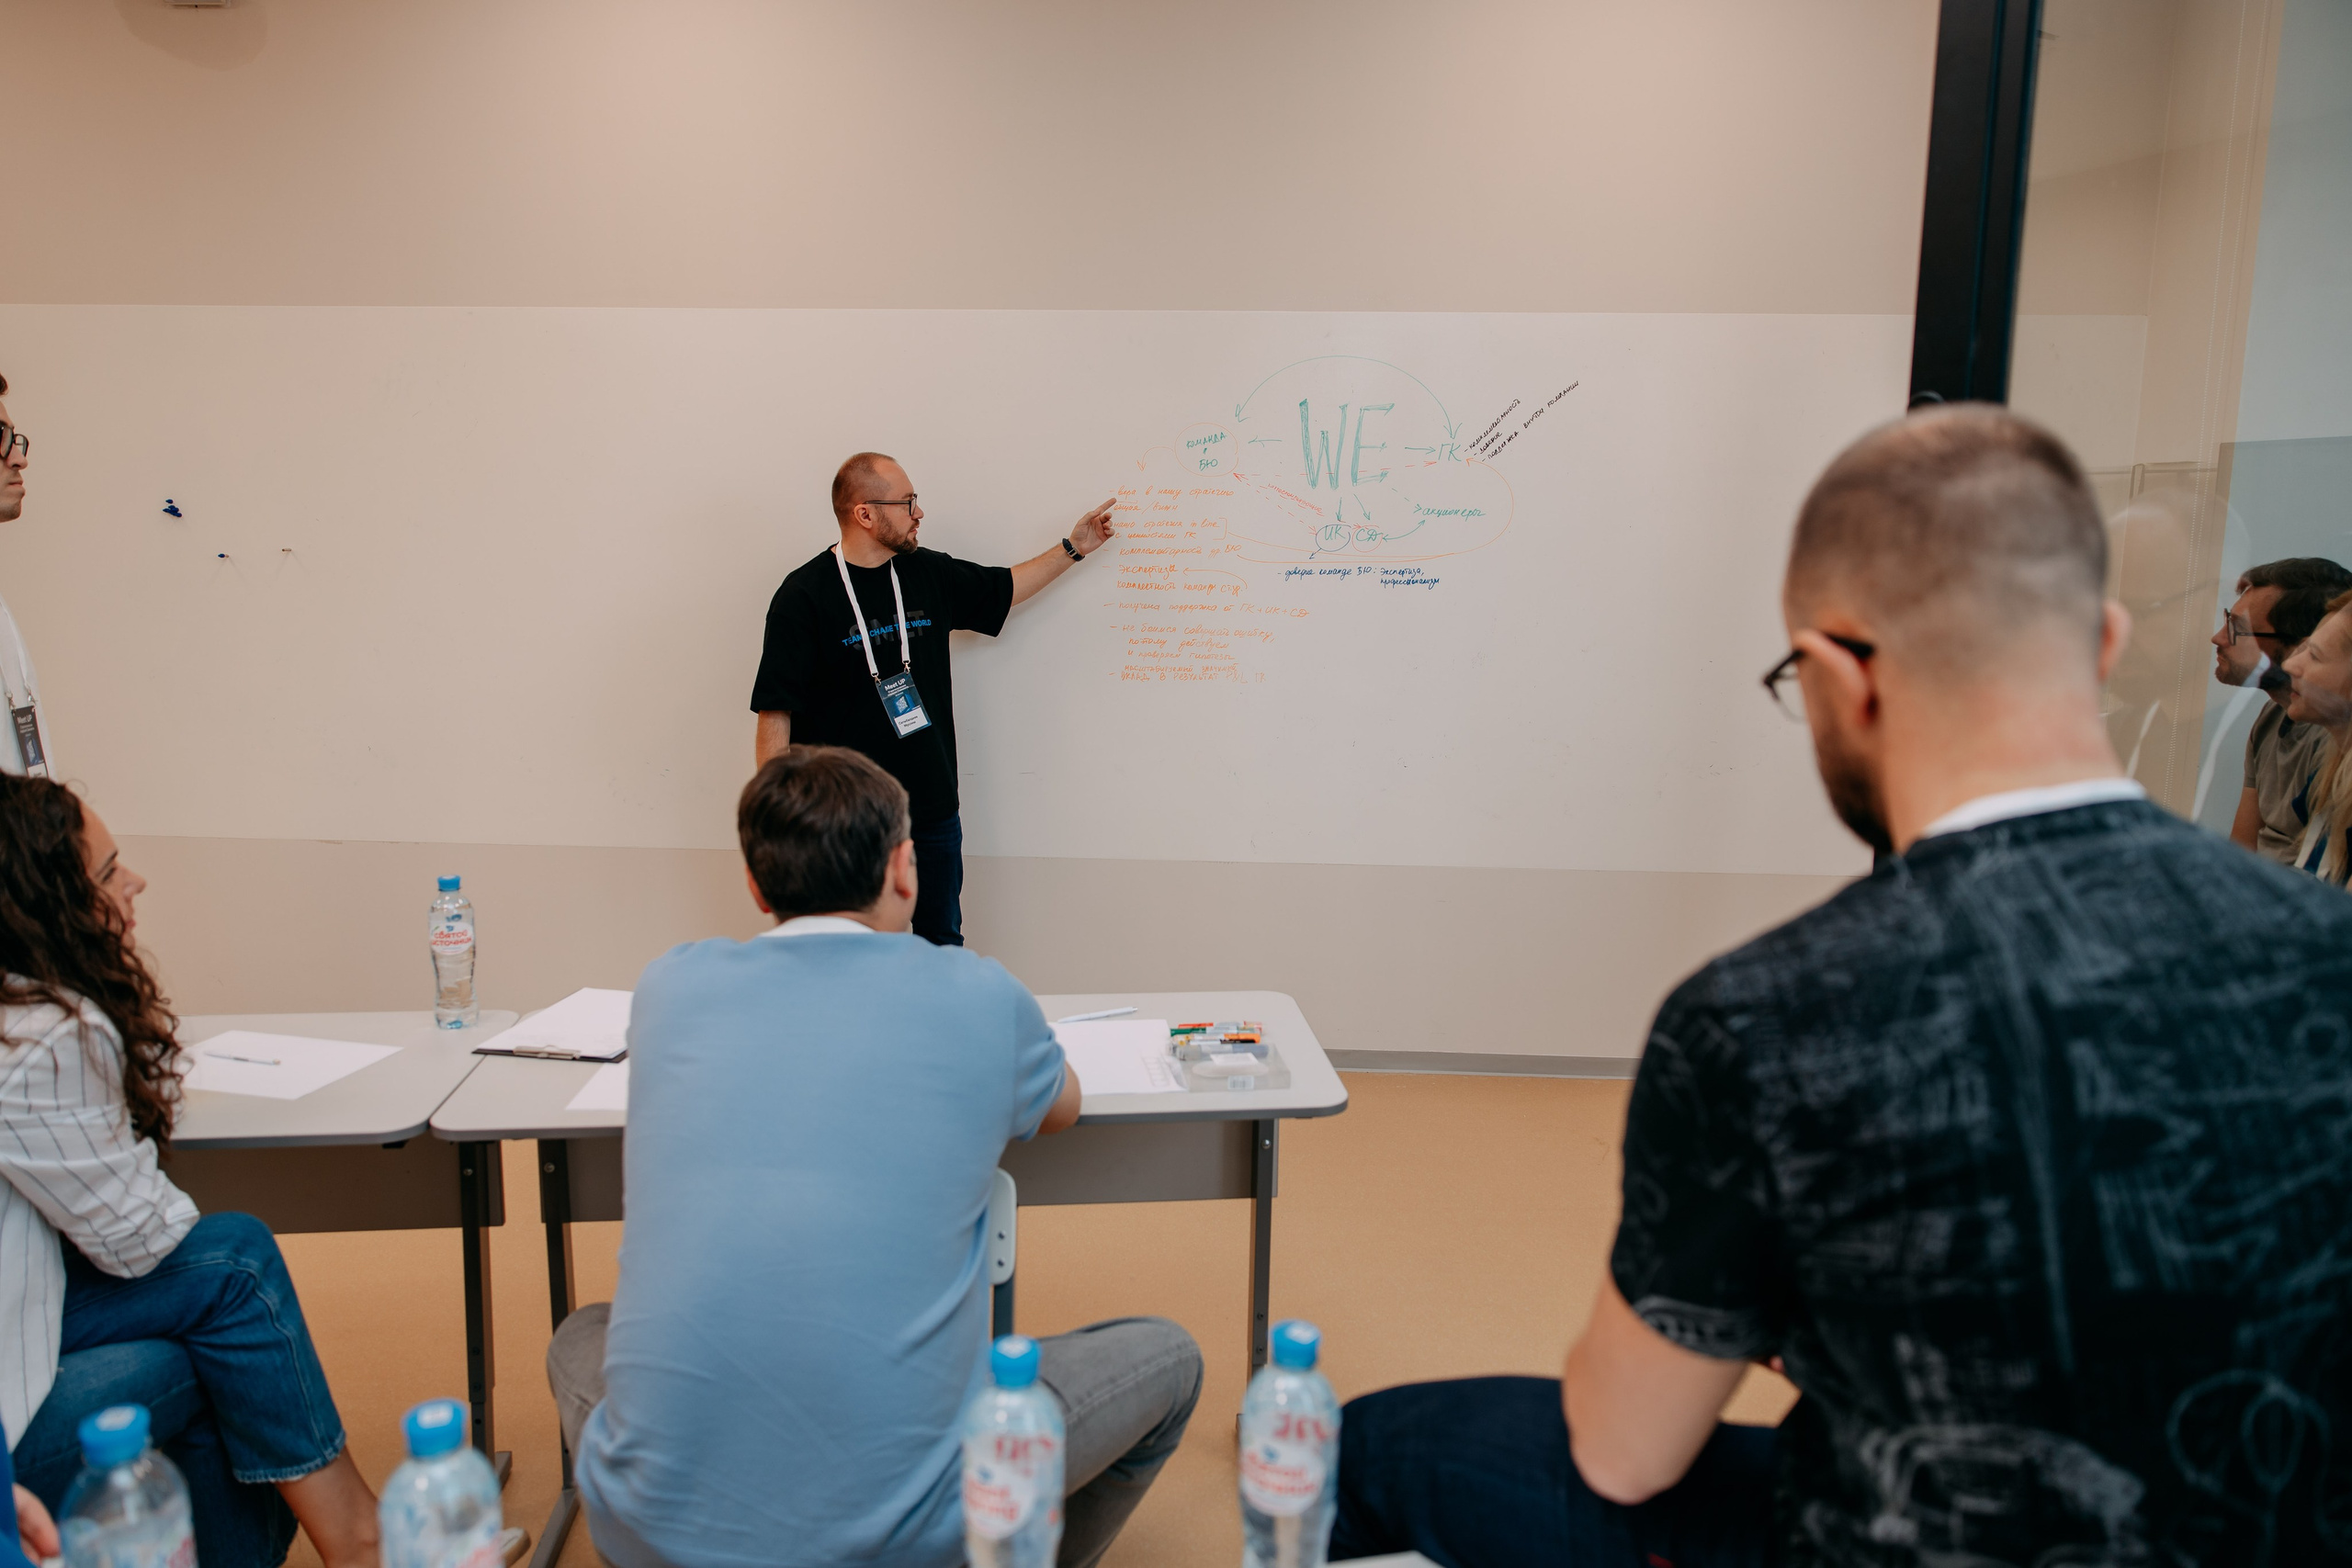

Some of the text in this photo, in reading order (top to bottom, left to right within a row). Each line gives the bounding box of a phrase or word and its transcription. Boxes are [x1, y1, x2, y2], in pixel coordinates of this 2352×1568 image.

[1186, 431, 1227, 449] КОМАНДА
[1298, 398, 1395, 490] WE
[1438, 442, 1463, 462] ГК
[894, 621, 911, 631] TE
[910, 618, 932, 627] WORLD
[884, 683, 899, 692] Meet
